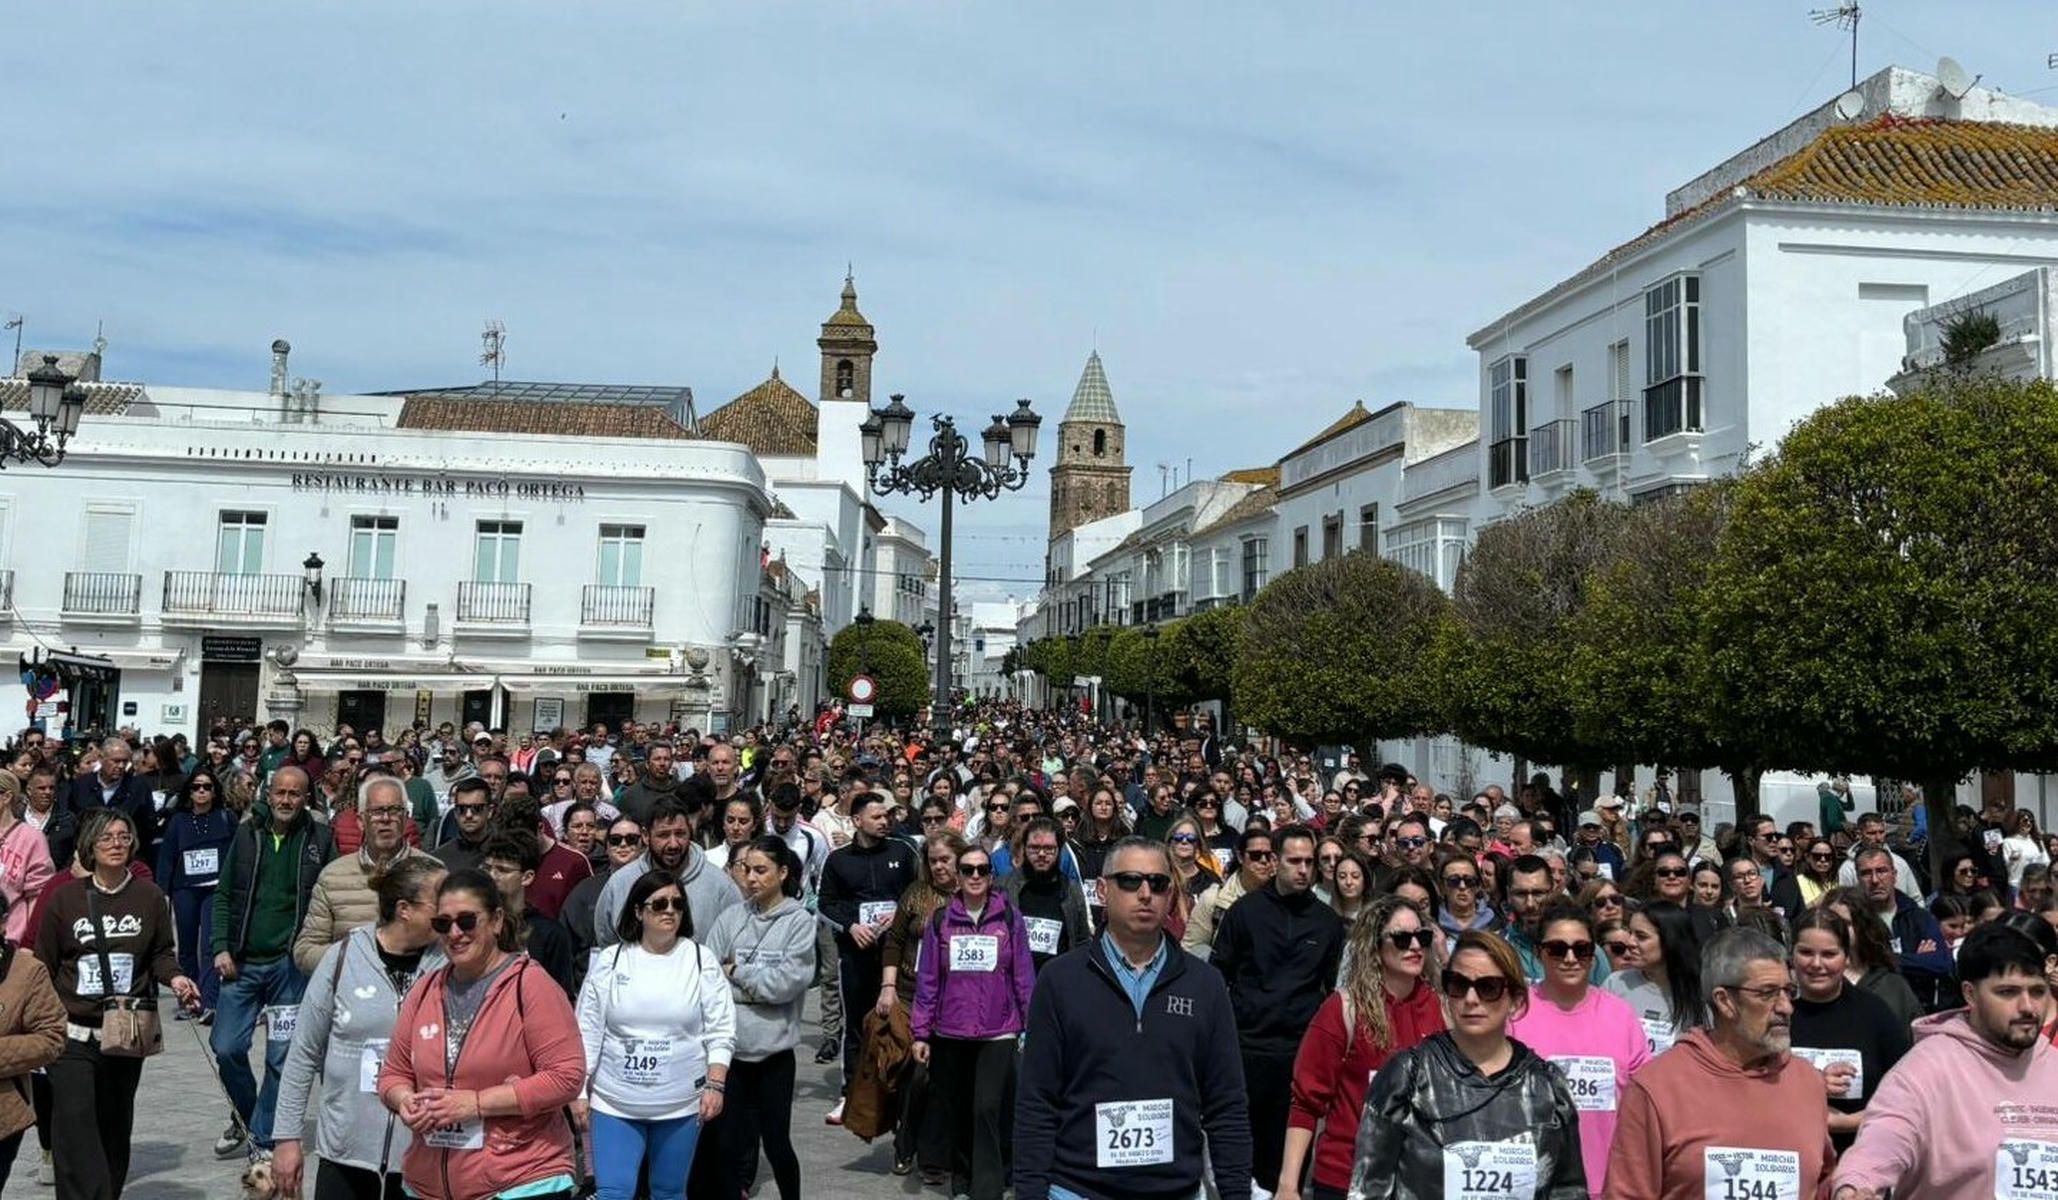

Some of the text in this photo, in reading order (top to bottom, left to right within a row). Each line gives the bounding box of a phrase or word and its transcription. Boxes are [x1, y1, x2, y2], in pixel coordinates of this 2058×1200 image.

[292, 473, 585, 497] RESTAURANTE BAR PACO ORTEGA
[330, 659, 389, 668] BAR PACO ORTEGA
[358, 680, 417, 690] BAR PACO ORTEGA
[576, 683, 635, 691] BAR PACO ORTEGA
[957, 949, 985, 961] 2583
[624, 1055, 657, 1071] 2149
[1108, 1127, 1154, 1149] 2673
[1462, 1170, 1513, 1193] 1224
[2012, 1167, 2058, 1192] 1543
[1724, 1179, 1777, 1200] 1544
